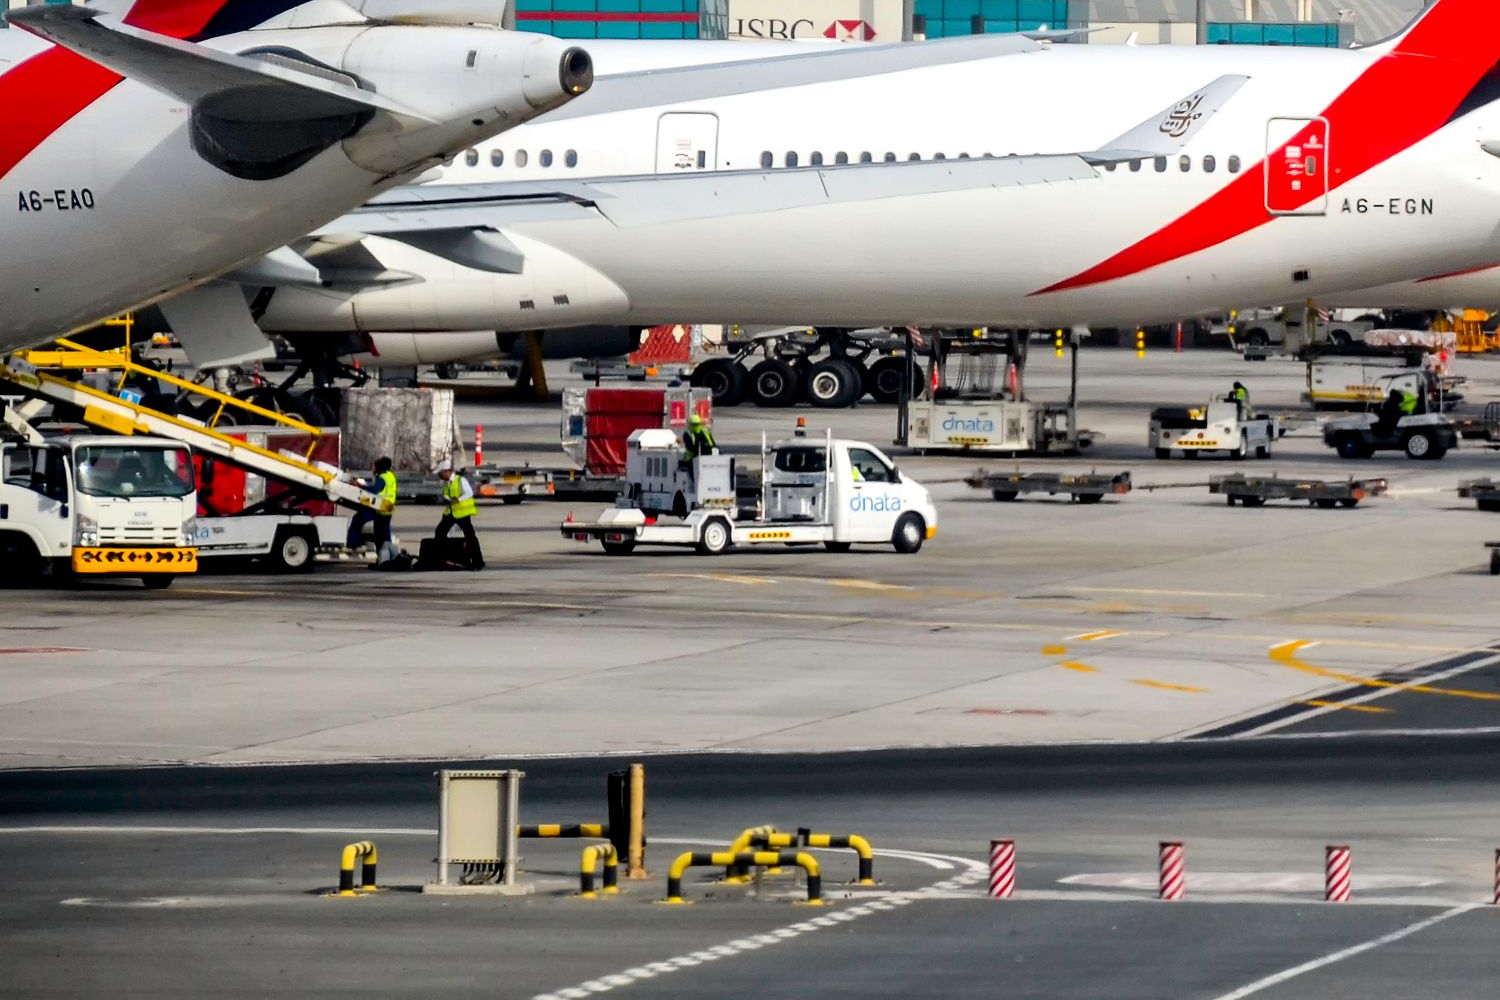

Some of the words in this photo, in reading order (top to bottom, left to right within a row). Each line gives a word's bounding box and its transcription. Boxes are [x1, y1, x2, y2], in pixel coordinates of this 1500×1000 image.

[1341, 197, 1434, 215] A6-EGN
[942, 416, 993, 432] dnata
[849, 491, 901, 511] dnata
